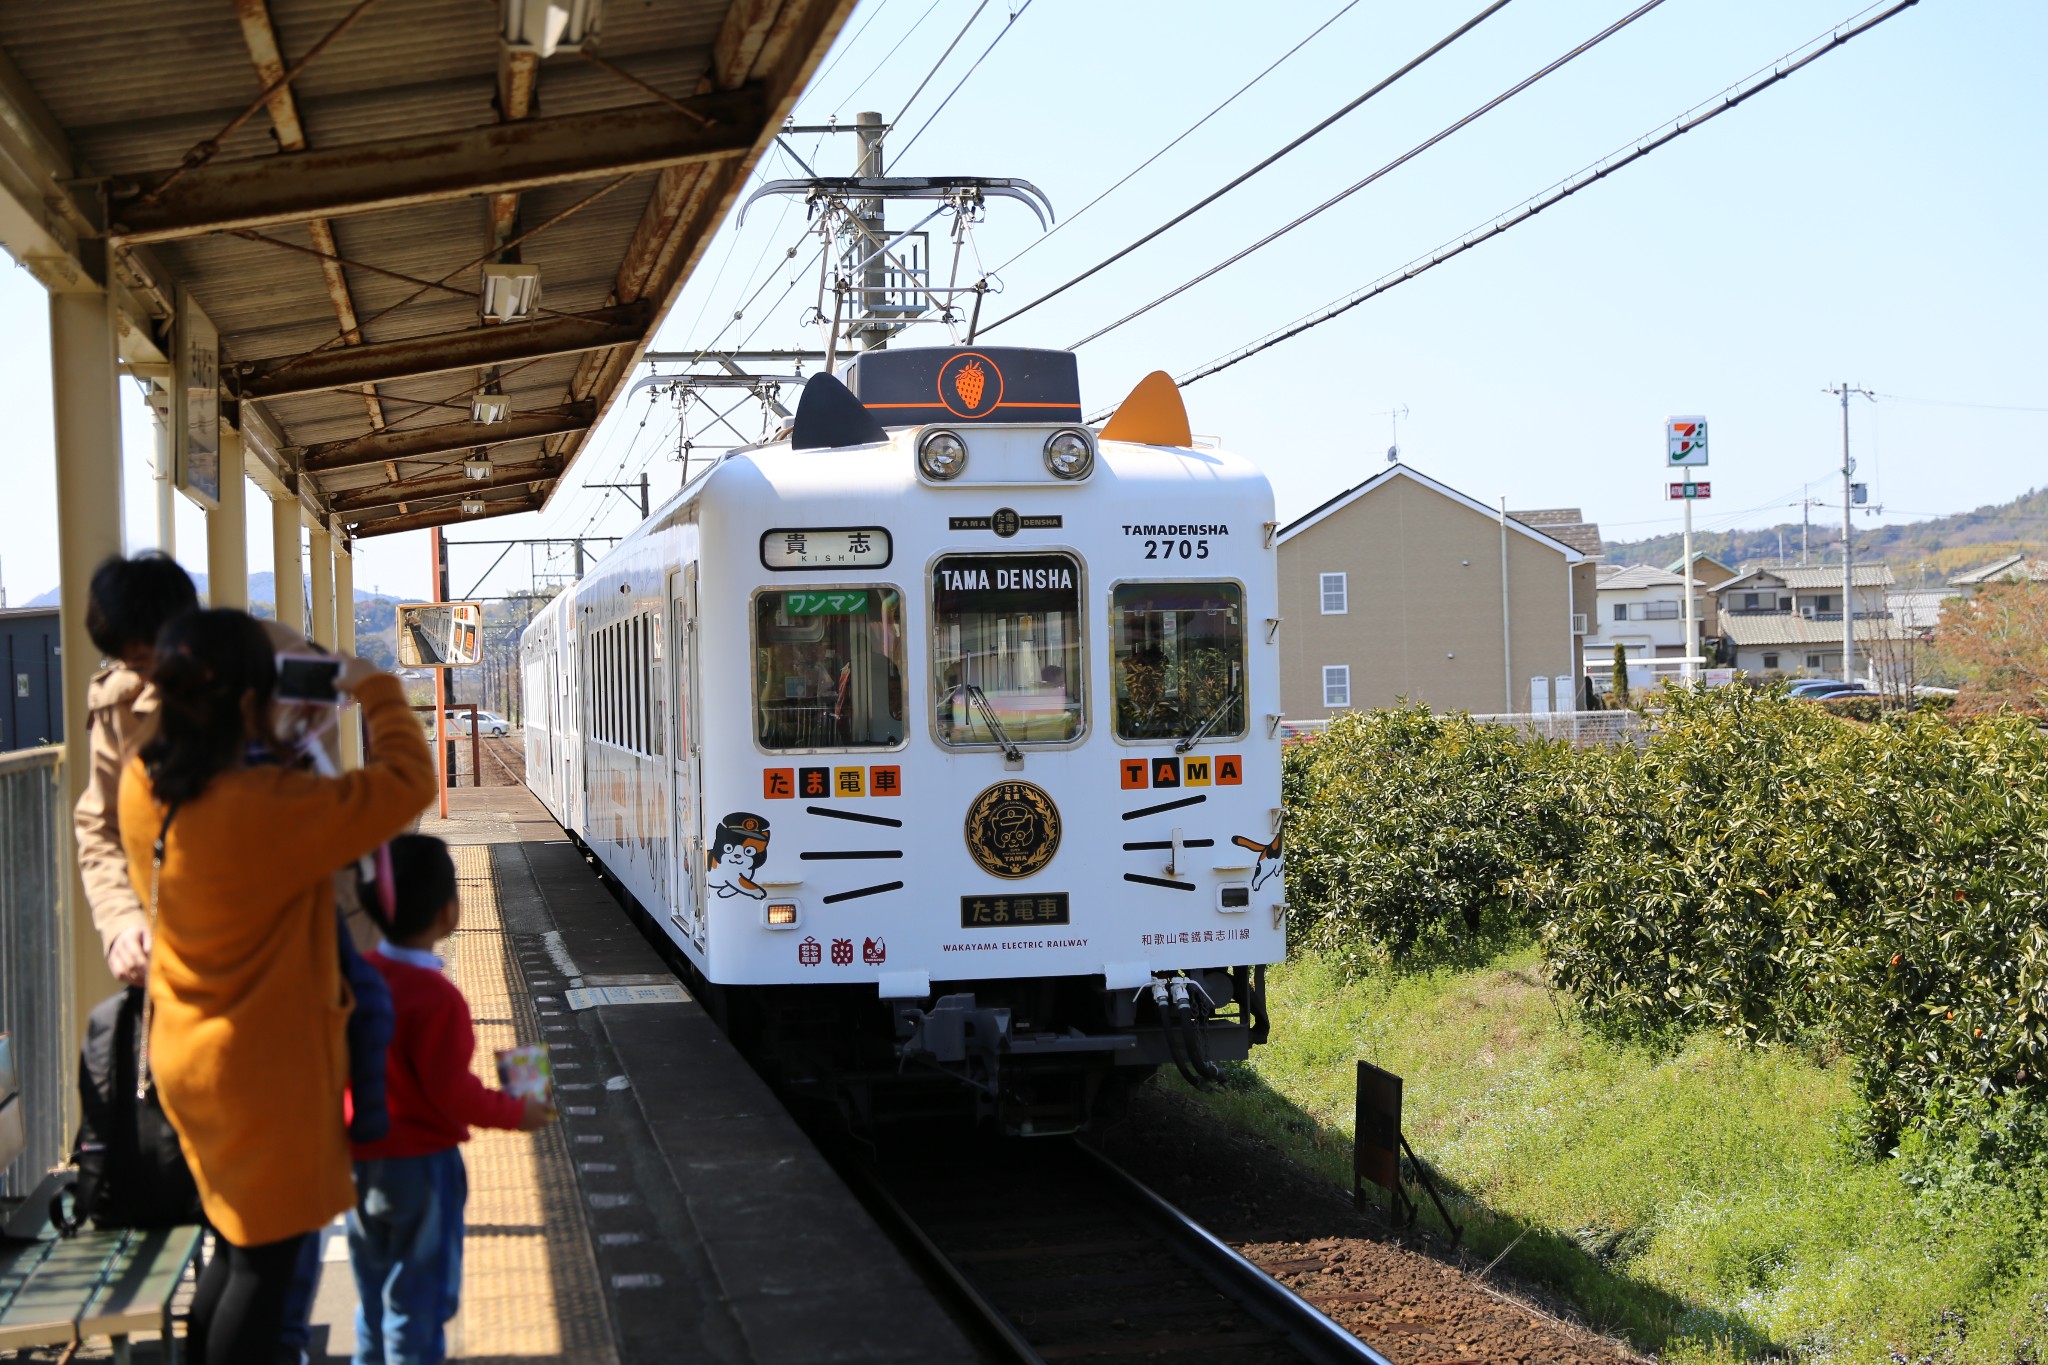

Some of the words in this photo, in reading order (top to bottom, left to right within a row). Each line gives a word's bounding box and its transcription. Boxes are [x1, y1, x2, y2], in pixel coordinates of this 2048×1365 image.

[1122, 524, 1229, 536] TAMADENSHA
[784, 532, 872, 555] 貴志
[1144, 540, 1210, 559] 2705
[801, 554, 857, 562] KISHI
[942, 570, 990, 591] TAMA
[997, 569, 1073, 590] DENSHA
[788, 593, 866, 613] ワンマン
[770, 770, 897, 795] たま電車
[1126, 762, 1238, 783] TAMA
[972, 898, 1059, 922] たま電車
[943, 943, 998, 952] WAKAYAMA
[1002, 941, 1044, 950] ELECTRIC
[1047, 939, 1088, 948] RAILWAY
